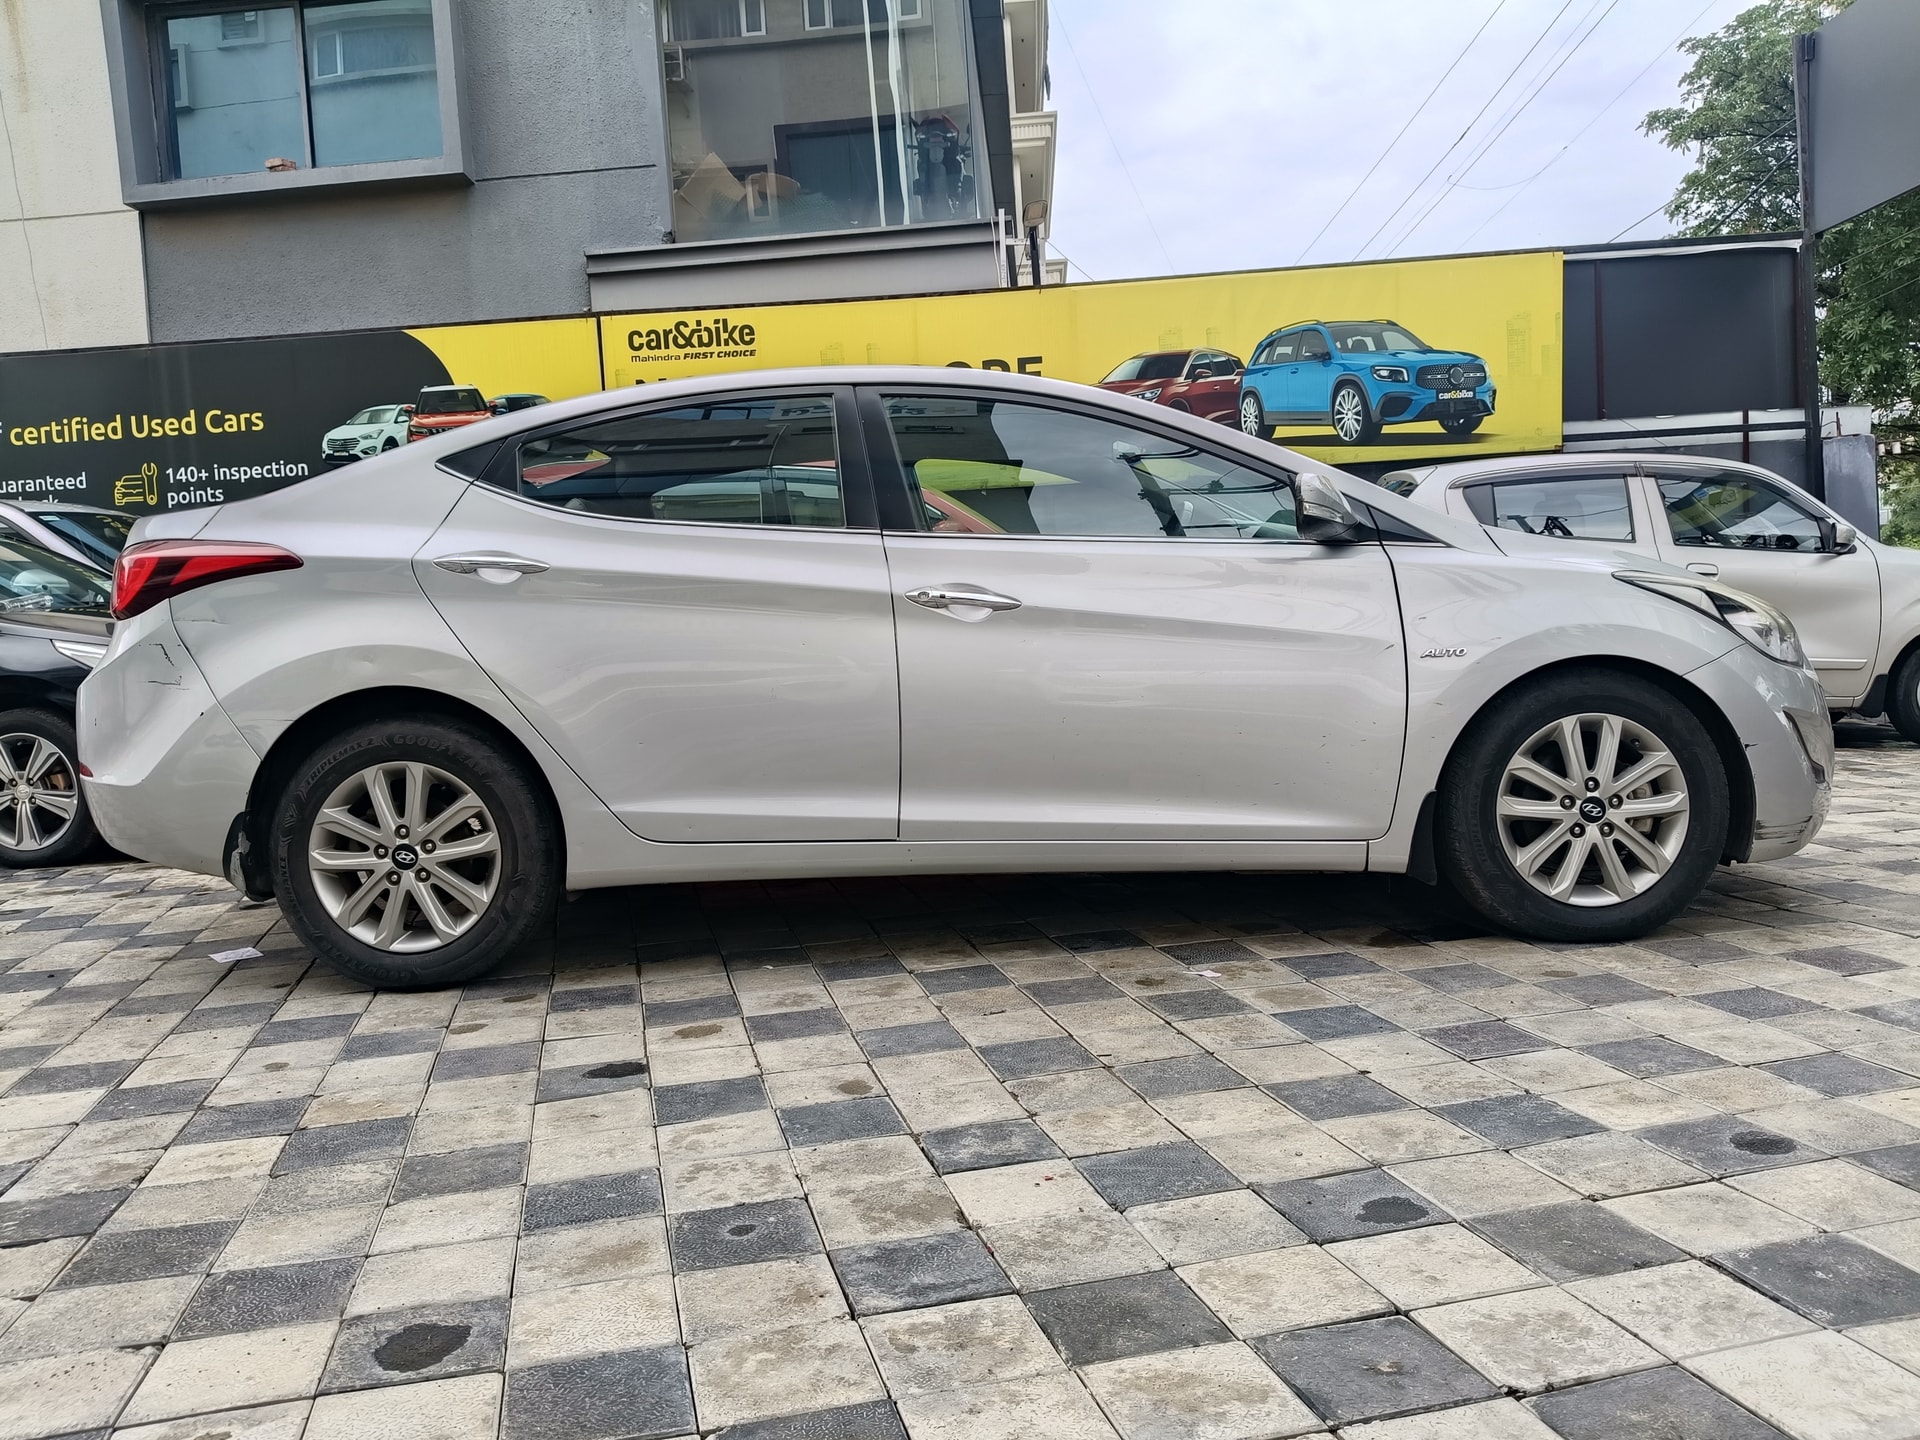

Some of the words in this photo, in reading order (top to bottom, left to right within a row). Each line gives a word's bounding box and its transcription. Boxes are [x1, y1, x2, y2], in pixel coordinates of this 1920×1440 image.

[627, 318, 756, 352] car&bike
[631, 354, 681, 363] Mahindra
[683, 351, 715, 360] FIRST
[717, 349, 757, 359] CHOICE
[9, 414, 123, 446] certified
[130, 409, 197, 439] Used
[204, 409, 265, 434] Cars
[165, 466, 209, 484] 140+
[213, 460, 309, 483] inspection
[167, 486, 224, 508] points
[1420, 647, 1467, 658] AUTO
[304, 740, 365, 787] TRIPLEMAX
